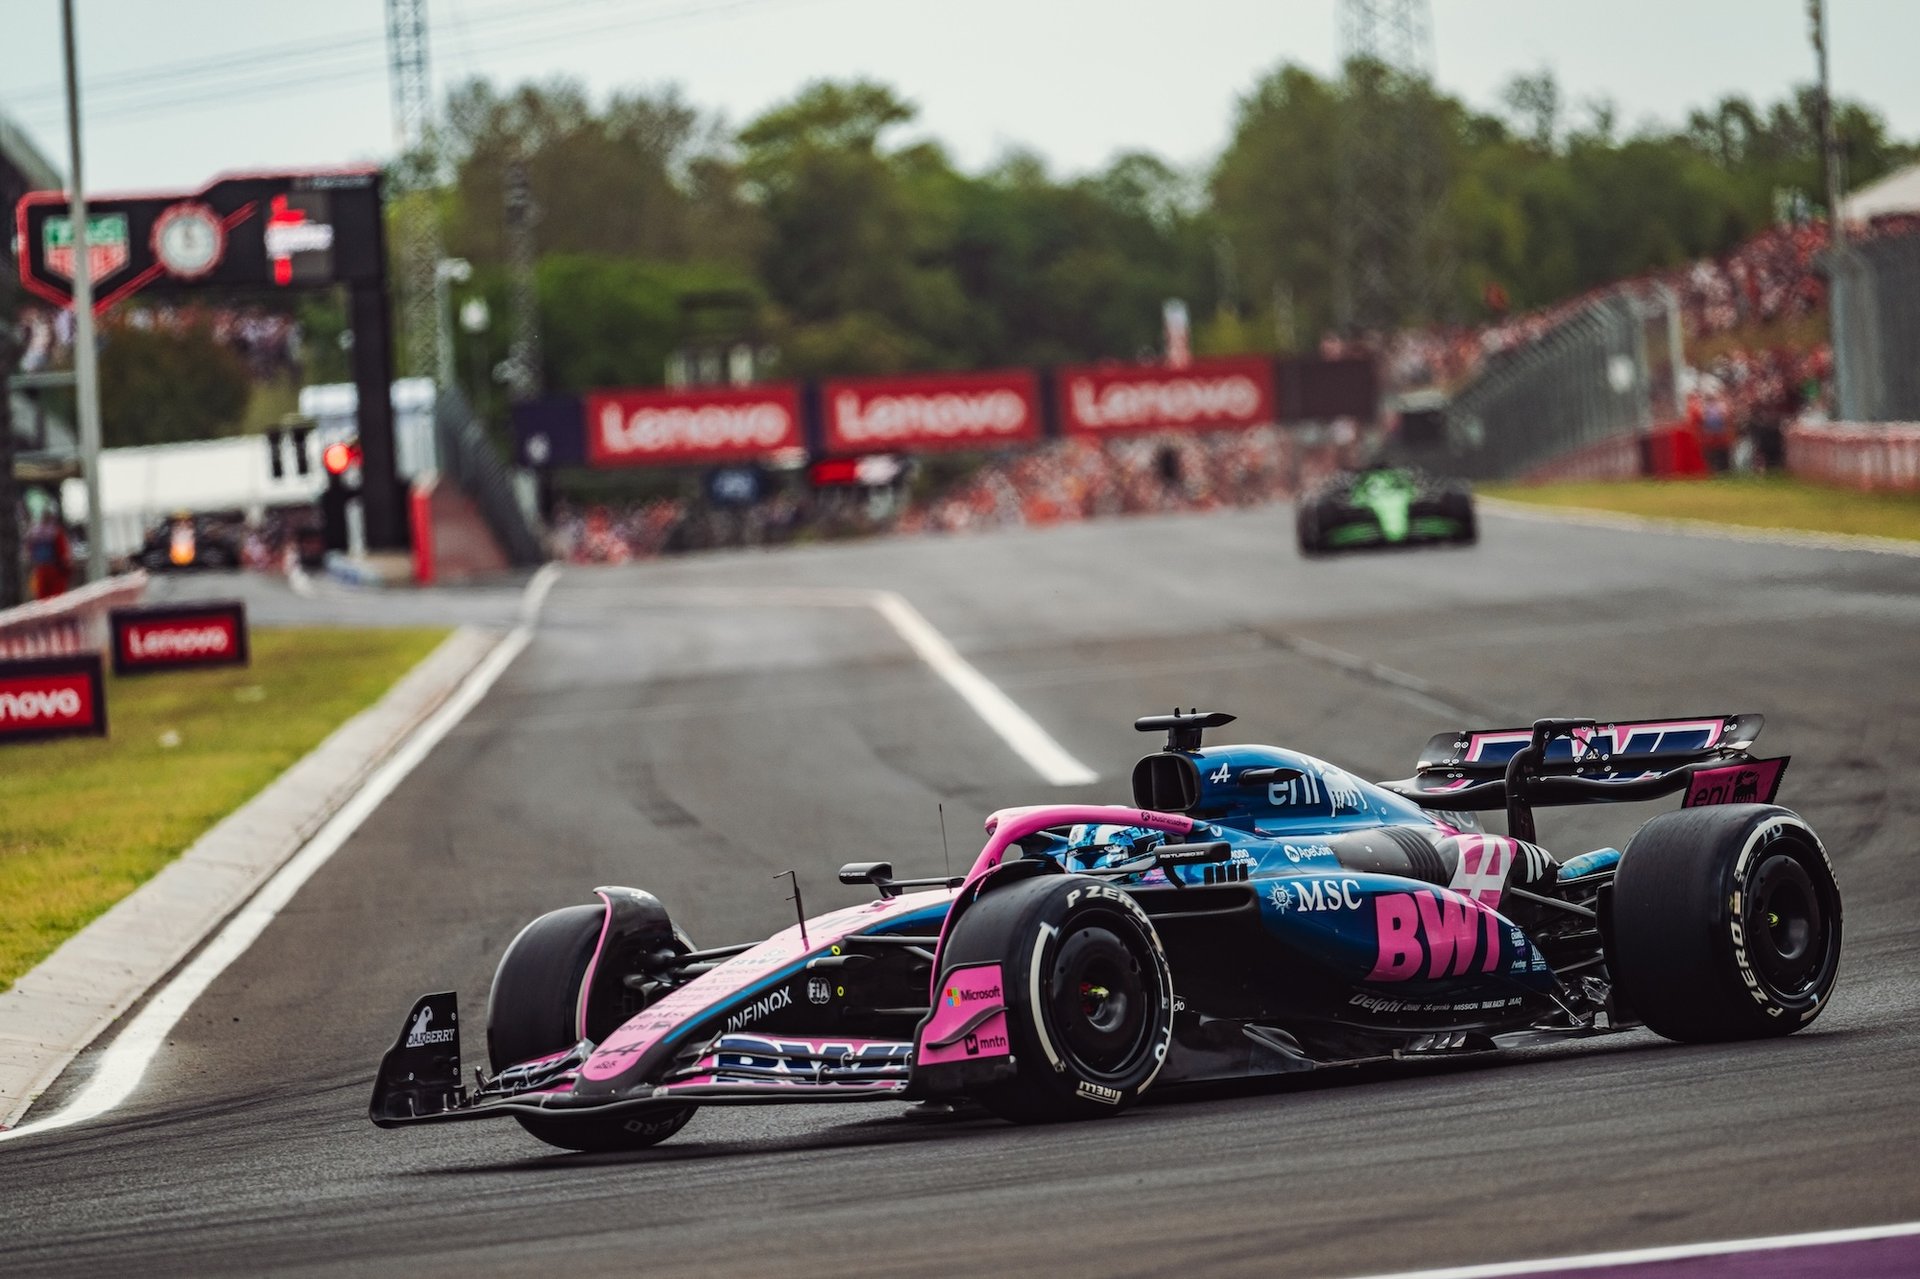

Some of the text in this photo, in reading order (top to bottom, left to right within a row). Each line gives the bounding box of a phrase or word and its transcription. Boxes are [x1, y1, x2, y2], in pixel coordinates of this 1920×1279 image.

[835, 388, 1027, 442] Lenovo
[1074, 376, 1263, 426] Lenovo
[601, 399, 791, 453] Lenovo
[128, 626, 229, 658] Lenovo
[1292, 878, 1363, 912] MSC
[1730, 921, 1769, 1005] ZERO
[727, 985, 792, 1034] INFINOX
[960, 985, 1001, 1001] Microsoft
[1349, 993, 1403, 1014] Delphi
[1453, 1002, 1479, 1011] MISSION
[407, 1028, 456, 1045] OAKBERRY
[1075, 1080, 1123, 1105] PIRELLI
